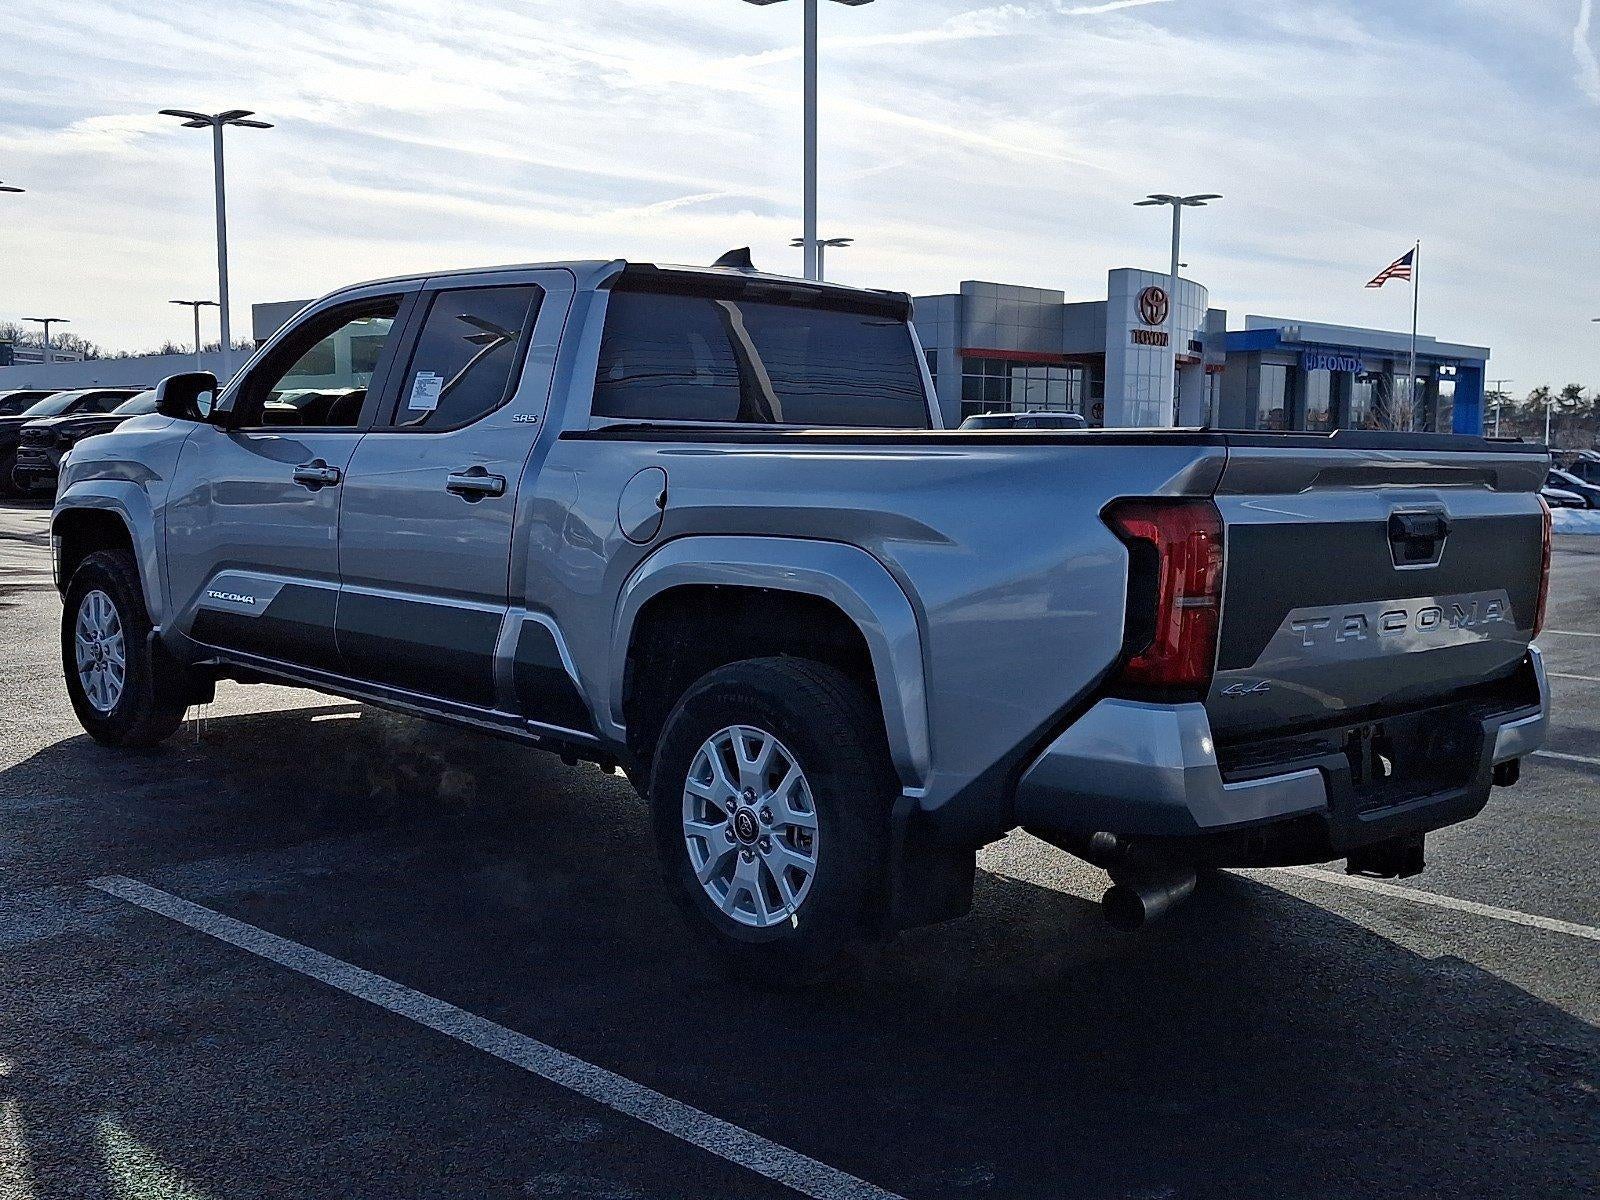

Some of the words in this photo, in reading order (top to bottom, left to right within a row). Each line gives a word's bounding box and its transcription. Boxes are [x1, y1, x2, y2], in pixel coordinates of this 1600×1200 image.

[1131, 329, 1169, 347] TOYOTA
[512, 413, 538, 424] SR5
[206, 590, 256, 605] TACOMA
[1290, 599, 1505, 647] TACOMA
